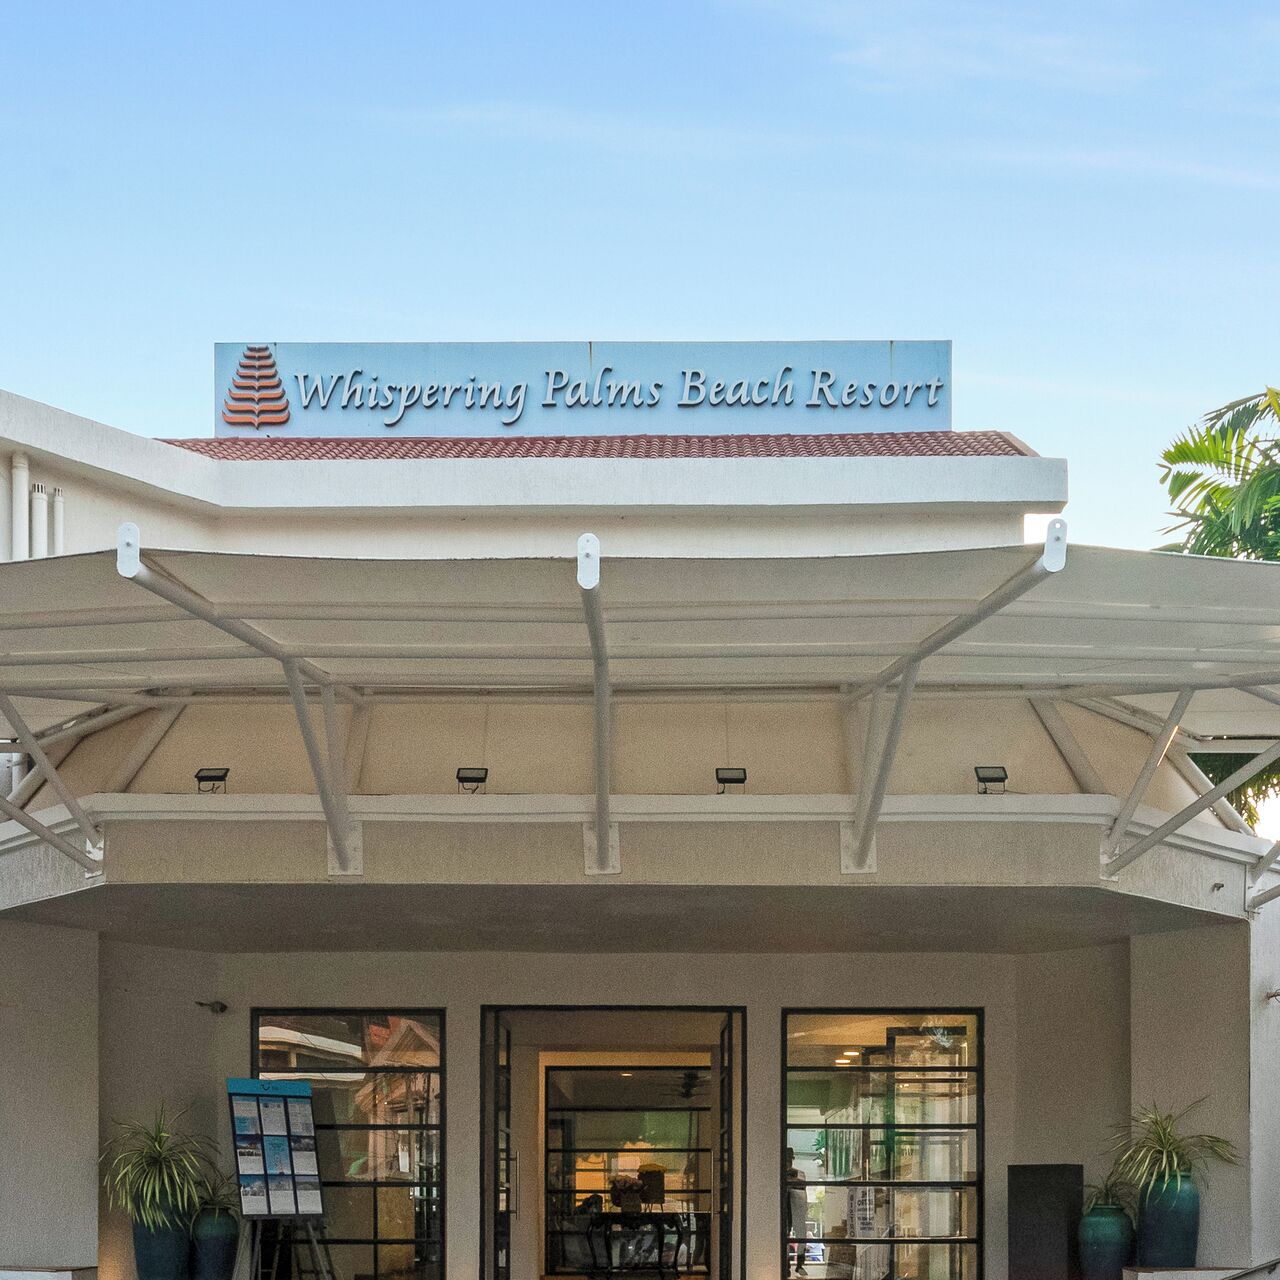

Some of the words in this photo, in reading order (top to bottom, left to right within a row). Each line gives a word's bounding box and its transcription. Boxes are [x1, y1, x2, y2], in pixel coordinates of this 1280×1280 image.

[294, 369, 528, 426] Whispering
[541, 367, 663, 409] Palms
[677, 366, 795, 408] Beach
[806, 368, 945, 408] Resort
